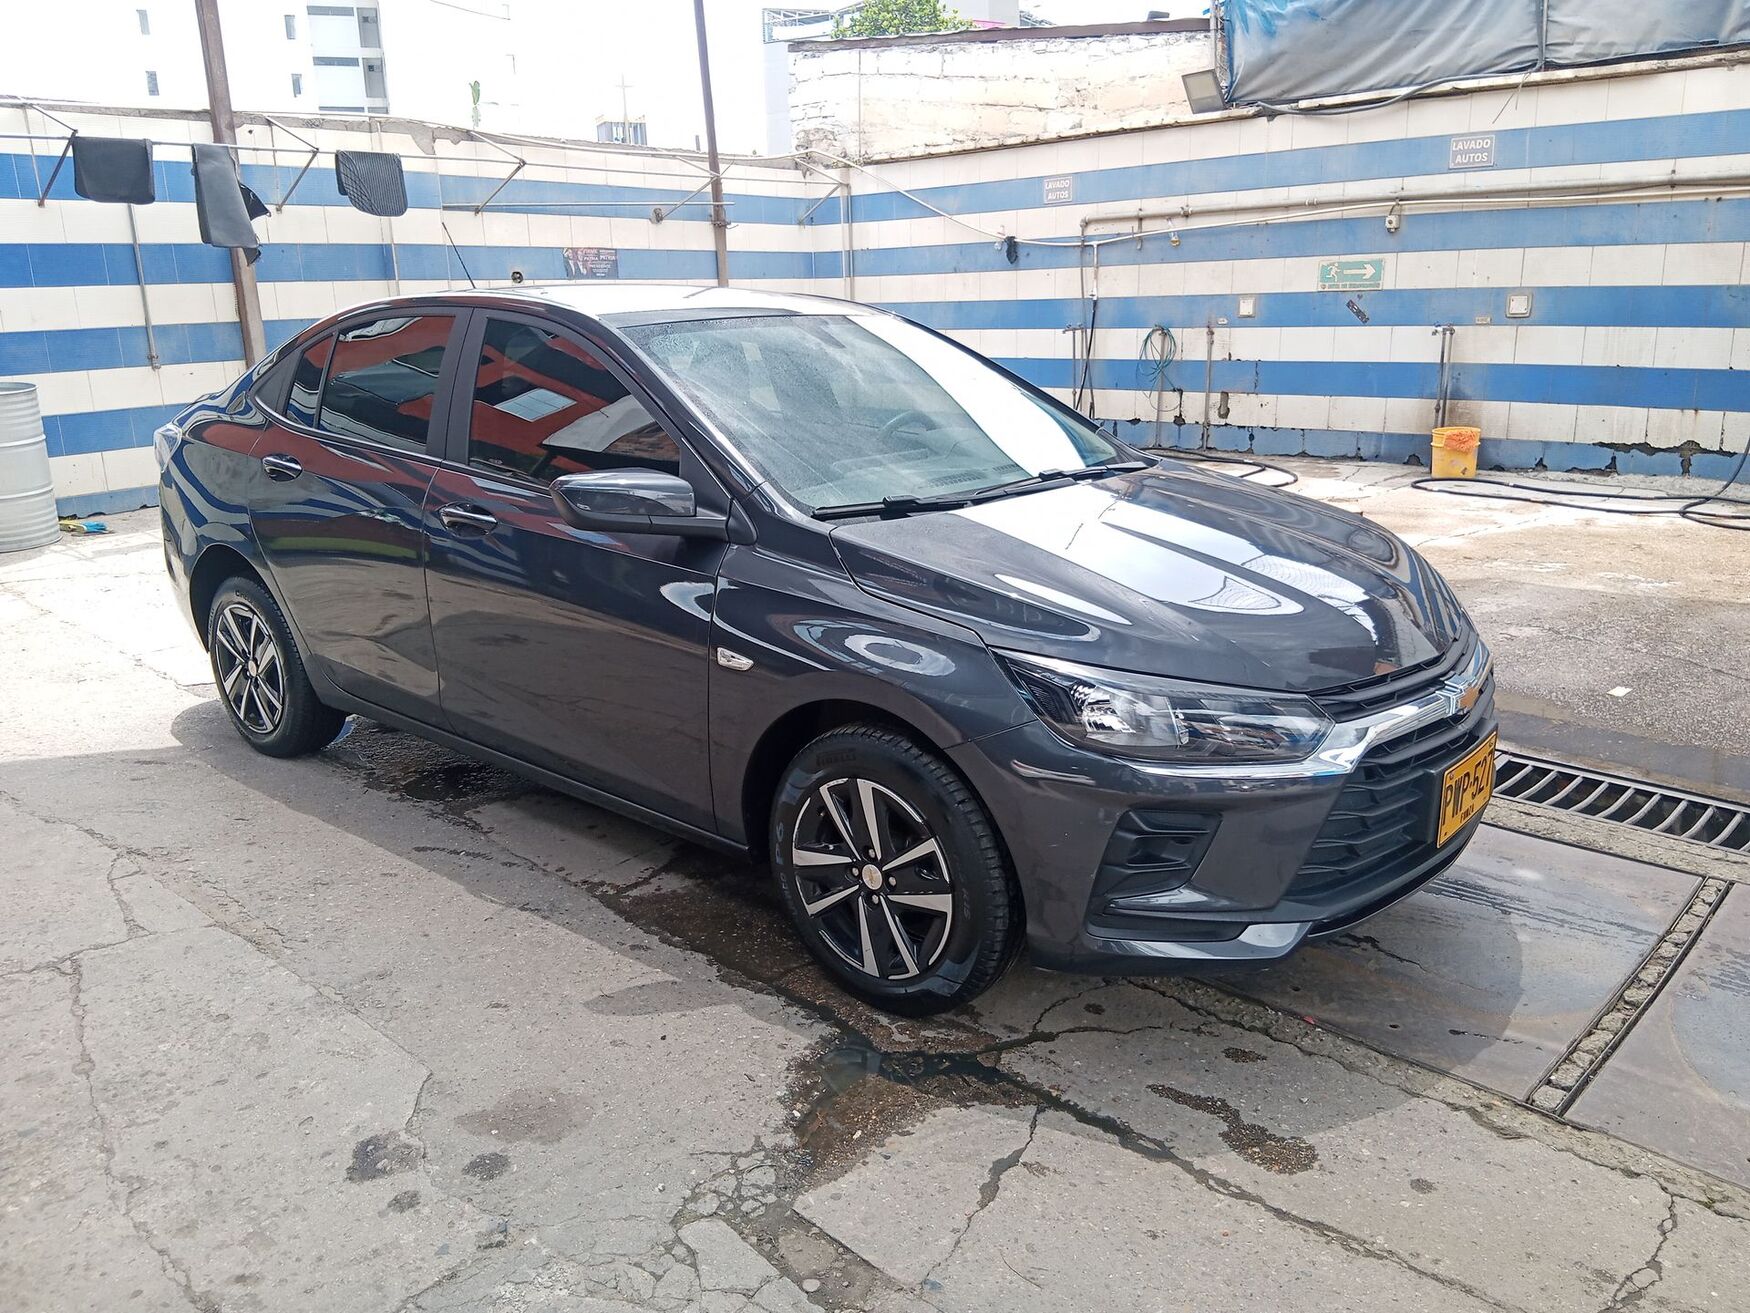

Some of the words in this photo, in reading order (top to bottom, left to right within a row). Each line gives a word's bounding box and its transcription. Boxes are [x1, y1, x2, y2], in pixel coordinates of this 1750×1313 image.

[1453, 139, 1491, 150] LAVADO
[1455, 153, 1488, 163] AUTOS
[1045, 180, 1070, 189] LAVADO
[1047, 191, 1069, 200] AUTOS
